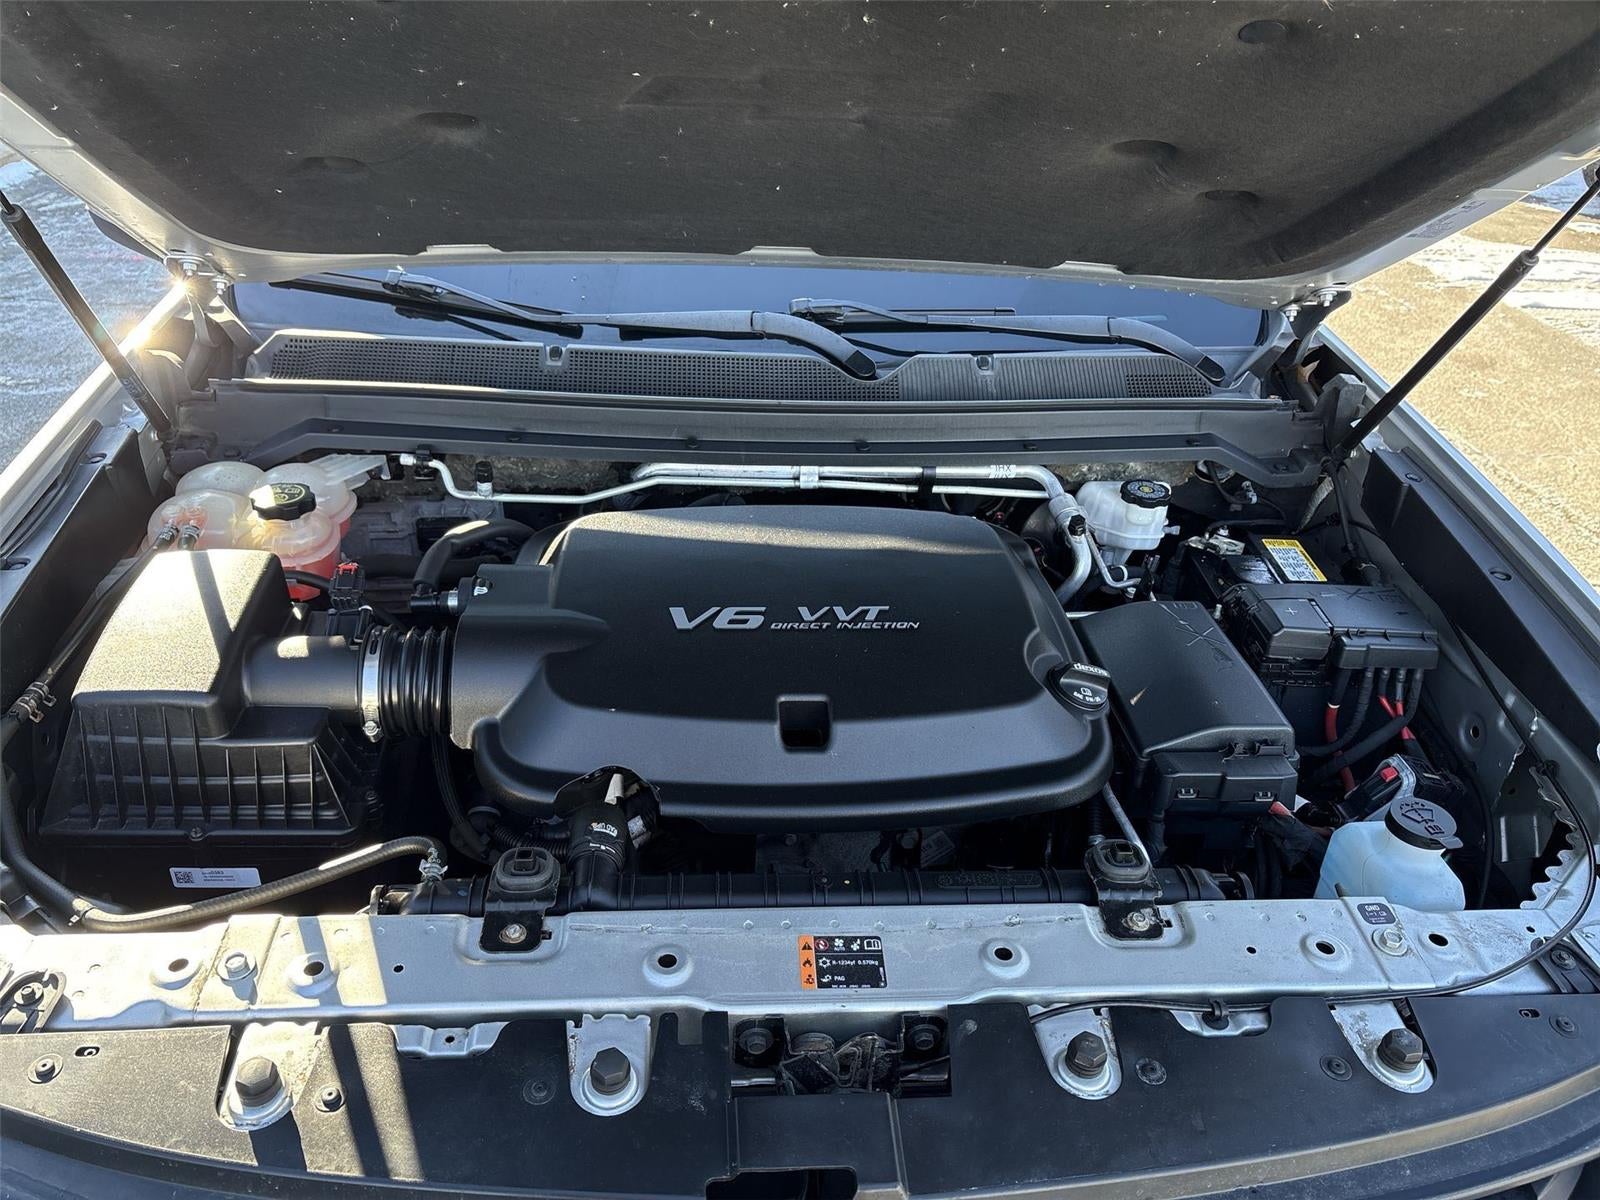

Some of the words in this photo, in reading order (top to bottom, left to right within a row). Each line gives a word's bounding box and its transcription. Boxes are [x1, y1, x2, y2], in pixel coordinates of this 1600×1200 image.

[668, 606, 767, 630] V6
[797, 605, 890, 621] VVT
[770, 621, 831, 630] DIRECT
[836, 621, 920, 630] INJECTION
